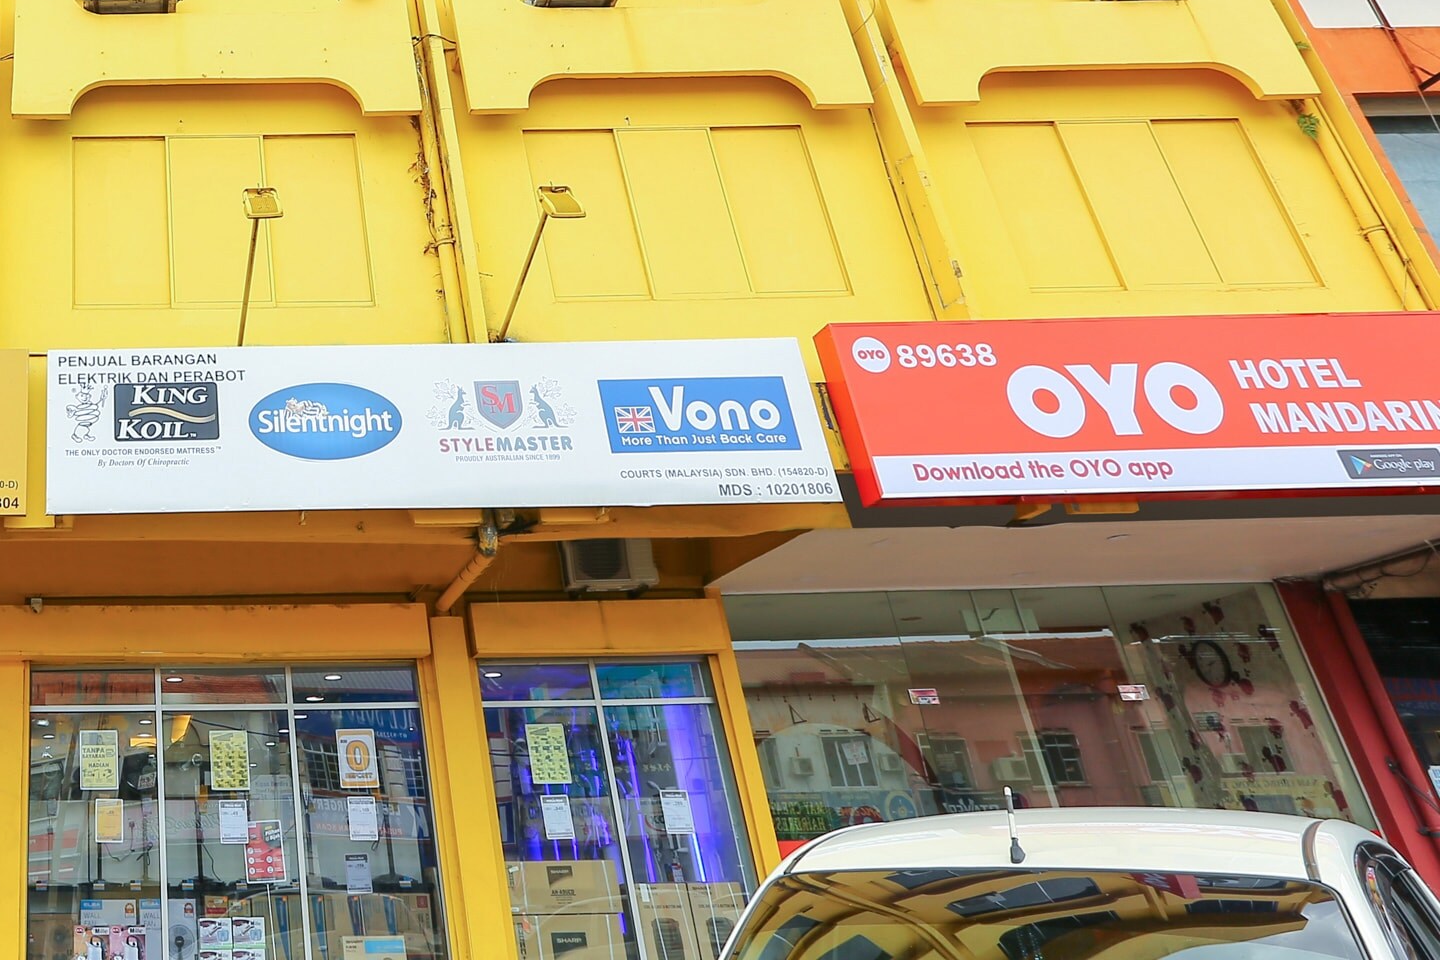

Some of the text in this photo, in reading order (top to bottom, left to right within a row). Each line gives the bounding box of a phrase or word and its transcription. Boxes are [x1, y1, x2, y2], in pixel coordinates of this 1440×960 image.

[58, 354, 217, 367] PENJUAL BARANGAN
[857, 343, 998, 369] OYO 89638
[58, 370, 246, 385] ELEKTRIK DAN PERABOT
[1228, 358, 1363, 389] HOTEL
[132, 385, 208, 405] KING
[1006, 361, 1225, 438] OYO
[648, 385, 781, 432] Vono
[257, 407, 394, 438] Silentnight
[439, 436, 573, 452] STYLEMASTER
[622, 433, 786, 446] More Than Just Back Care
[620, 467, 828, 479] COURTS (MALAYSIA) SDN. BHD. (154820-D)
[912, 458, 1173, 482] Download the OYO app
[1373, 458, 1435, 473] Google play
[719, 484, 752, 496] MDS
[766, 483, 833, 495] 10201806
